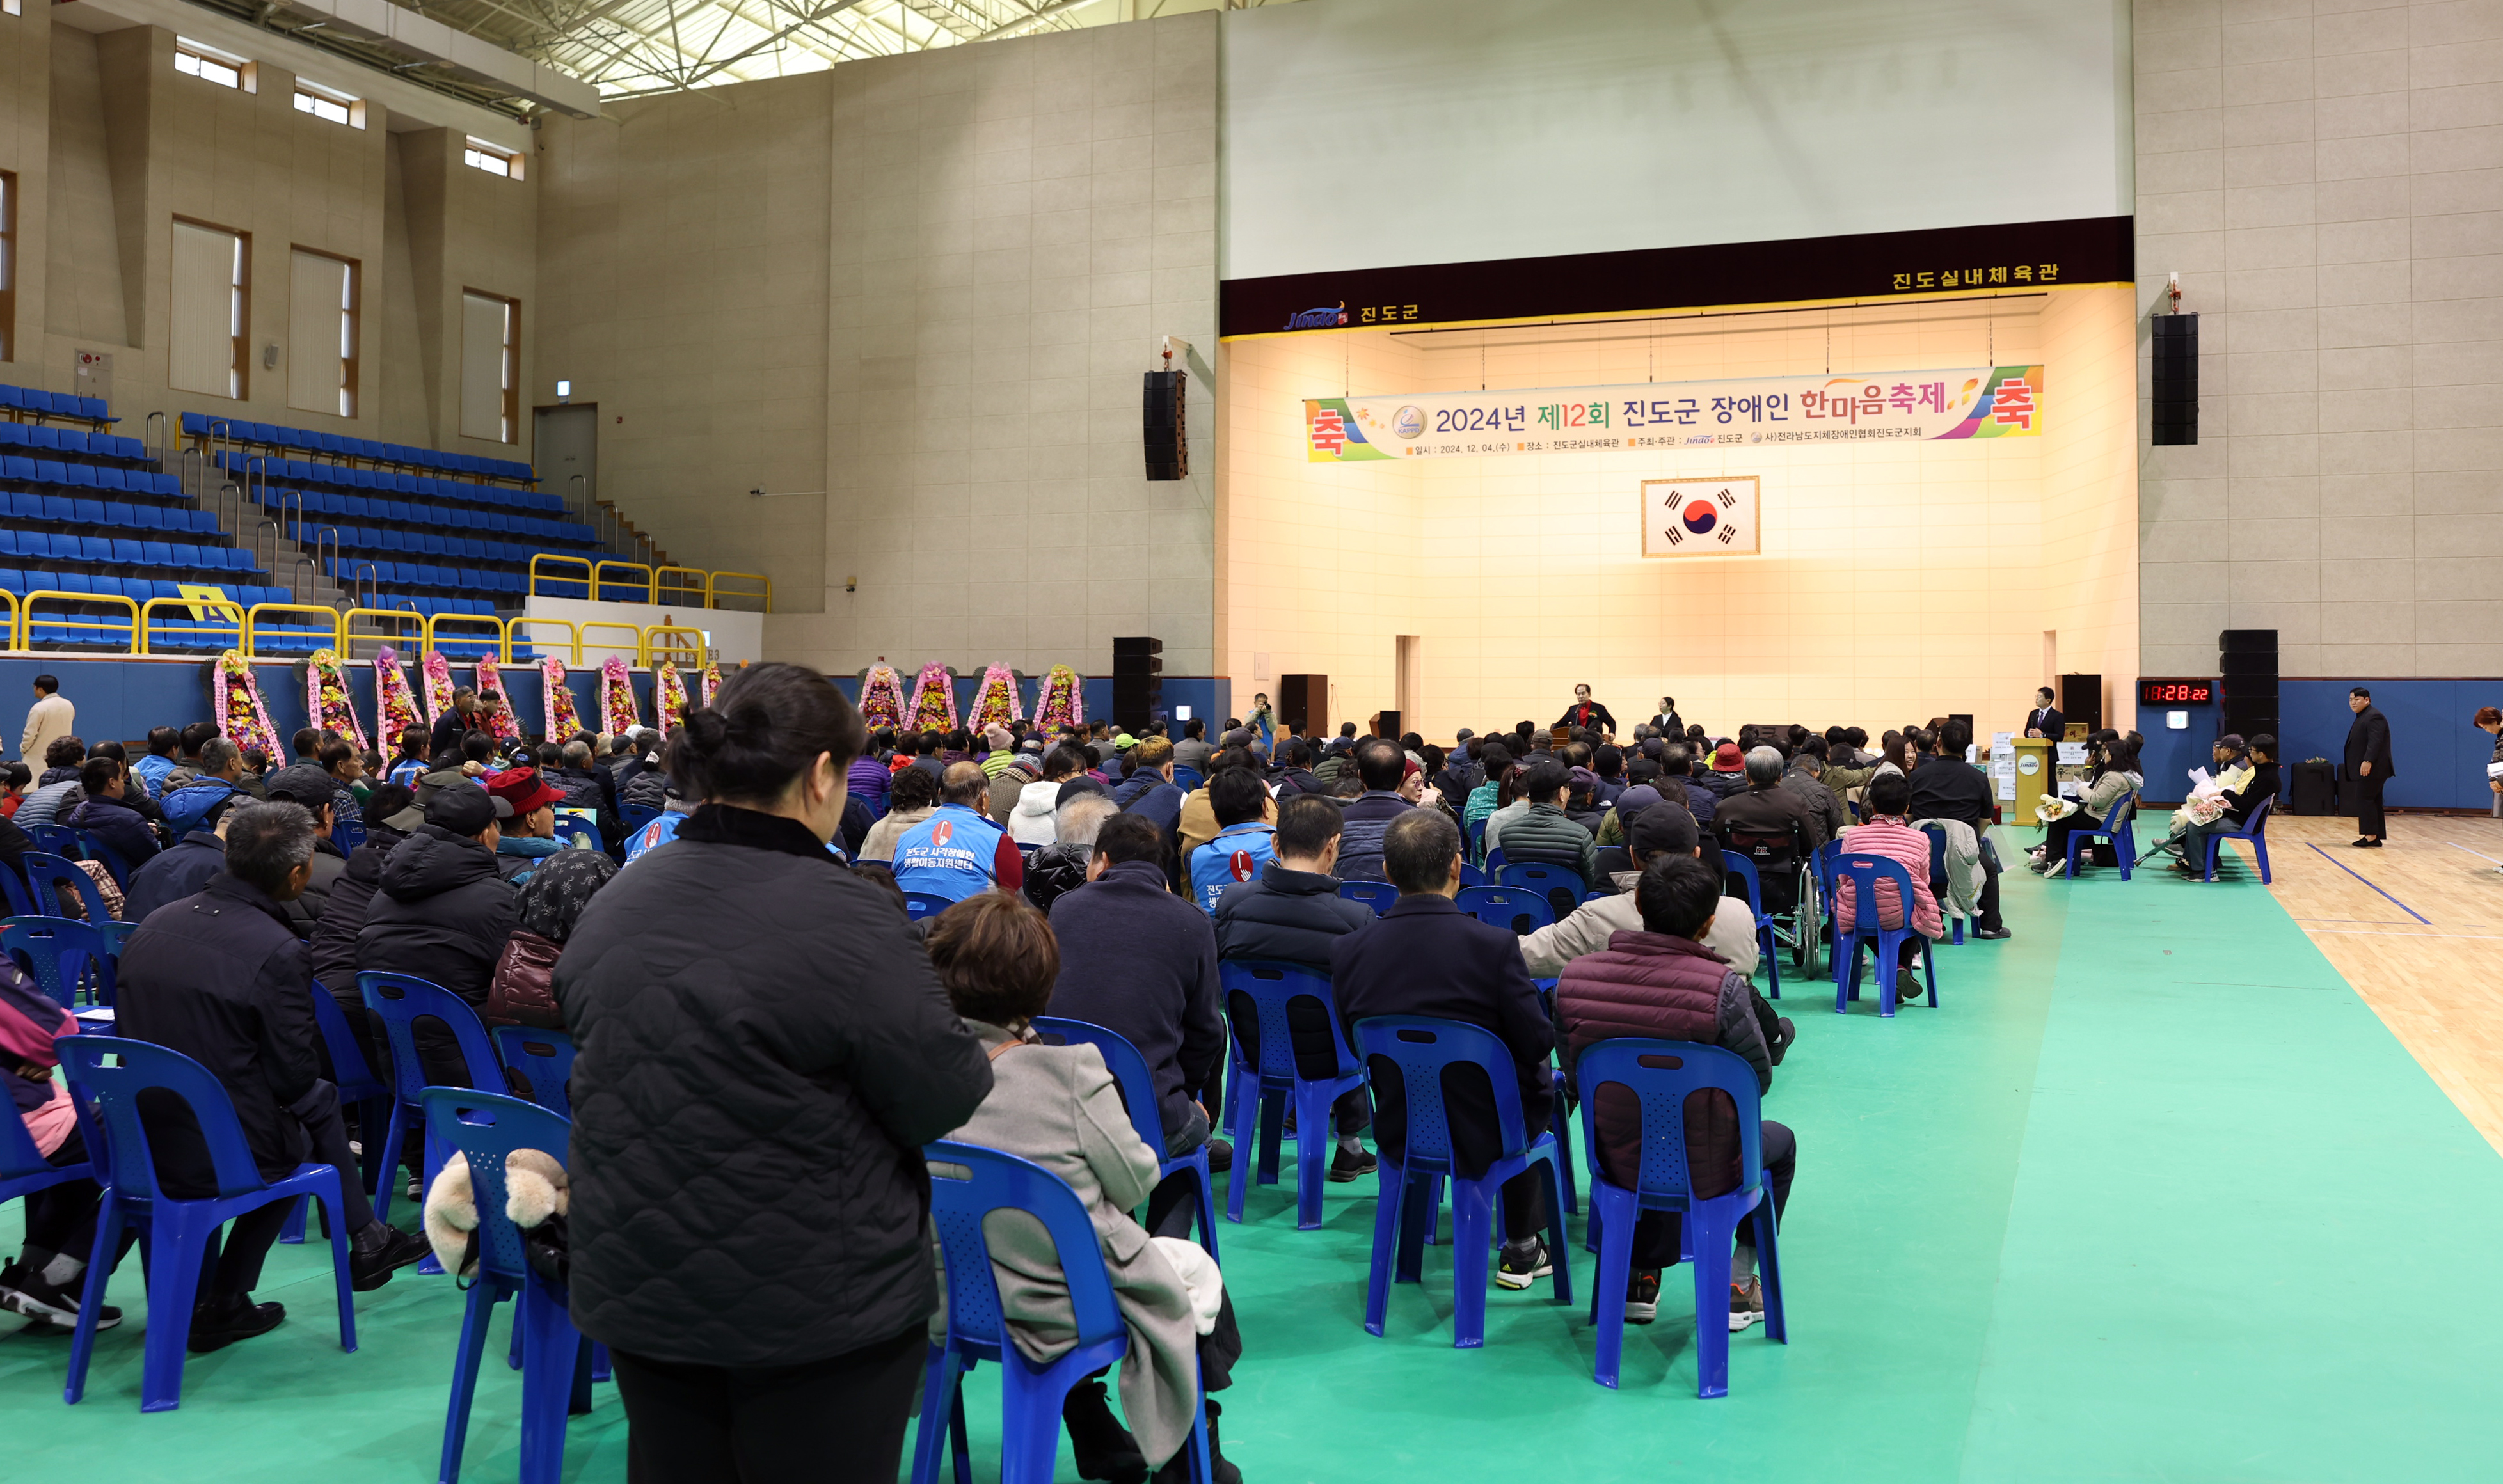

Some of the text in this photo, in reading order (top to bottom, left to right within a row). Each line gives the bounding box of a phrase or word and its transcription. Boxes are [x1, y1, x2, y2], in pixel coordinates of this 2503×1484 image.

[1893, 264, 2059, 290] 진도실내체육관
[1283, 304, 1418, 329] Jindo 진도군
[1992, 379, 2035, 430] 축
[1436, 405, 1525, 432] 2024년
[1538, 401, 1609, 430] 제12회
[1623, 399, 1700, 427] 진도군
[1711, 393, 1788, 423] 장애인
[1312, 410, 1346, 455] 축
[1765, 427, 1921, 441] 사)전라남도지체장애인협회진도군지회
[1527, 441, 1543, 451] 장소
[1553, 438, 1619, 450] 진도군실내체육관
[1637, 436, 1674, 446] 주최·주관
[1684, 435, 1710, 445] Jindo
[1717, 434, 1743, 443] 진도군
[1415, 446, 1431, 455] 일시
[1441, 445, 1463, 454] 2024.
[1467, 445, 1478, 453] 12.
[1482, 443, 1510, 452] 04.(수)
[906, 847, 975, 861] 진도군 시각장애인
[904, 857, 973, 871] 생활이동지원센터
[1207, 884, 1228, 896] 진도
